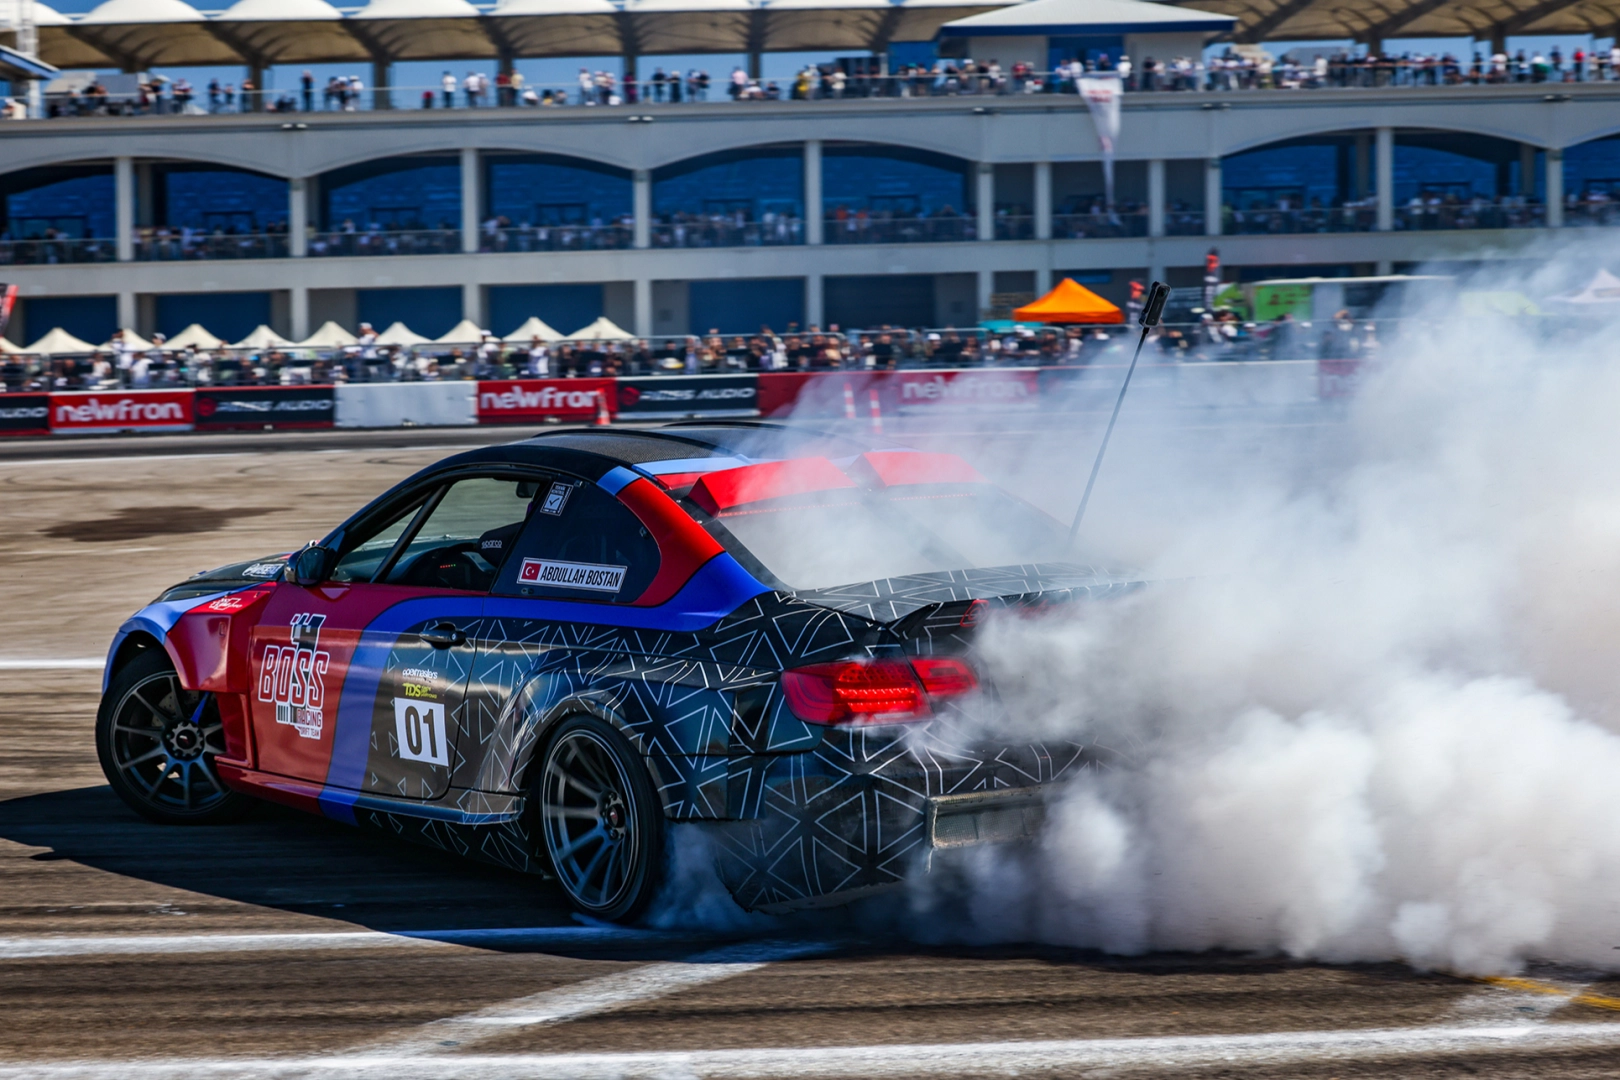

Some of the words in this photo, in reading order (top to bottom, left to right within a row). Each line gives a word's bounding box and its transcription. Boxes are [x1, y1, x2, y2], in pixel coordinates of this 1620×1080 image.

[56, 398, 184, 422] newfron
[540, 566, 587, 585] ABDULLAH
[585, 569, 621, 587] BOSTAN
[258, 645, 330, 709] BOSS
[402, 683, 421, 697] TDS
[296, 707, 321, 727] RACING
[405, 705, 438, 758] 01
